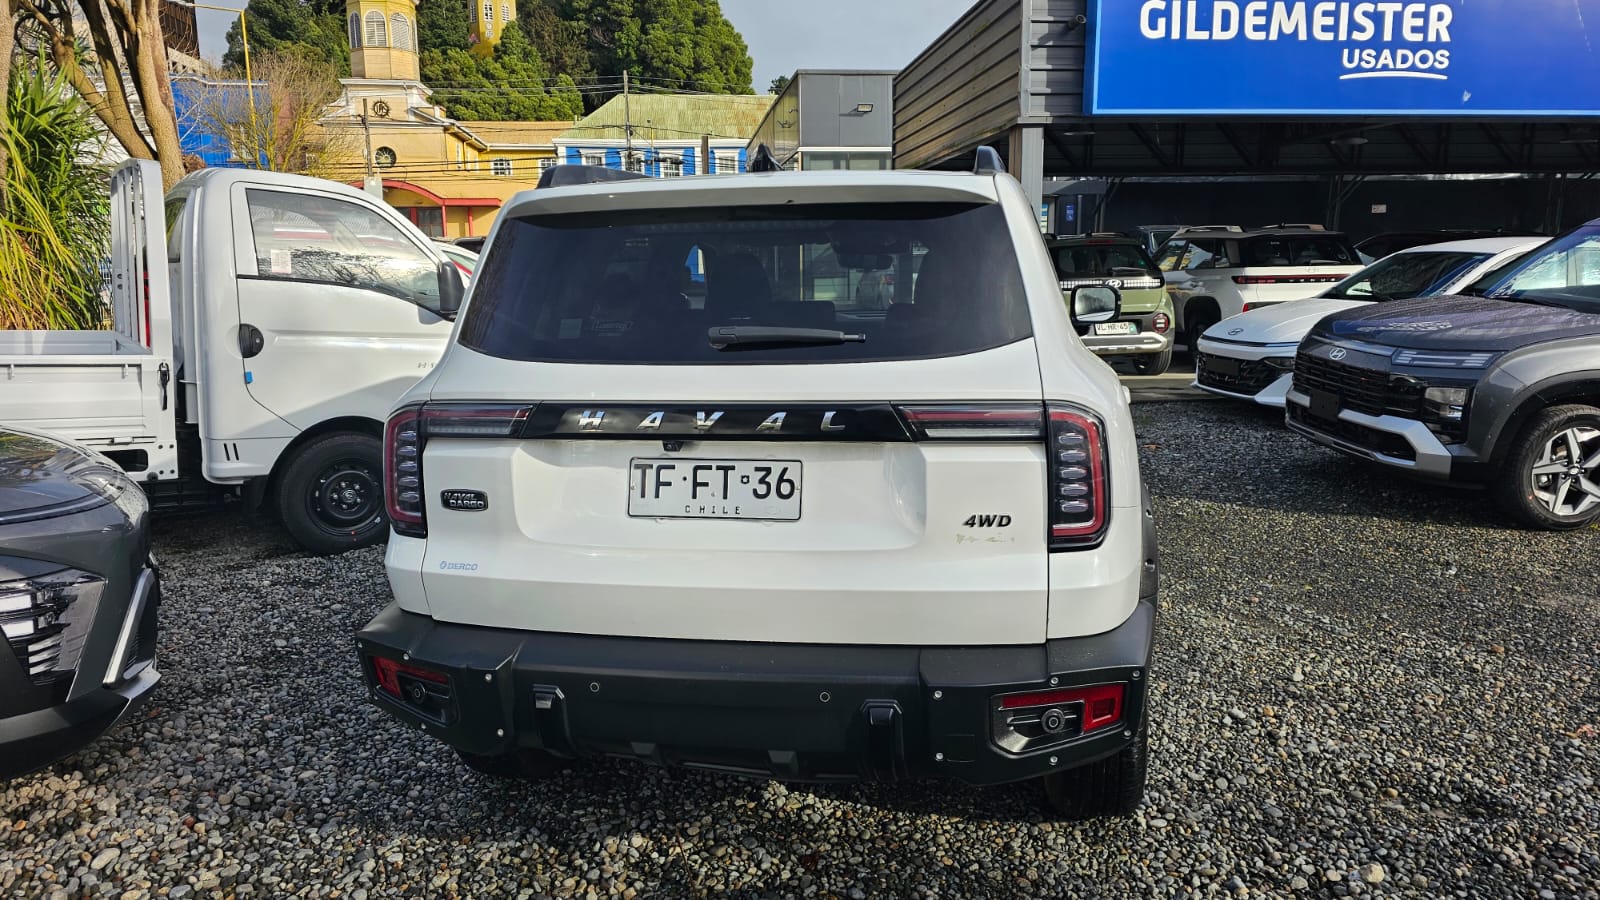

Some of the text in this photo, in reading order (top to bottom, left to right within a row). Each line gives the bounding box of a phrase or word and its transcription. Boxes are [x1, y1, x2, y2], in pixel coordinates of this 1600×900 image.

[1140, 0, 1453, 42] GILDEMEISTER
[1342, 49, 1450, 69] USADOS
[577, 410, 846, 432] HAVAL
[449, 500, 484, 508] DARGO
[685, 505, 741, 515] CHILE
[962, 514, 1012, 528] 4WD
[447, 562, 478, 571] DERCO
